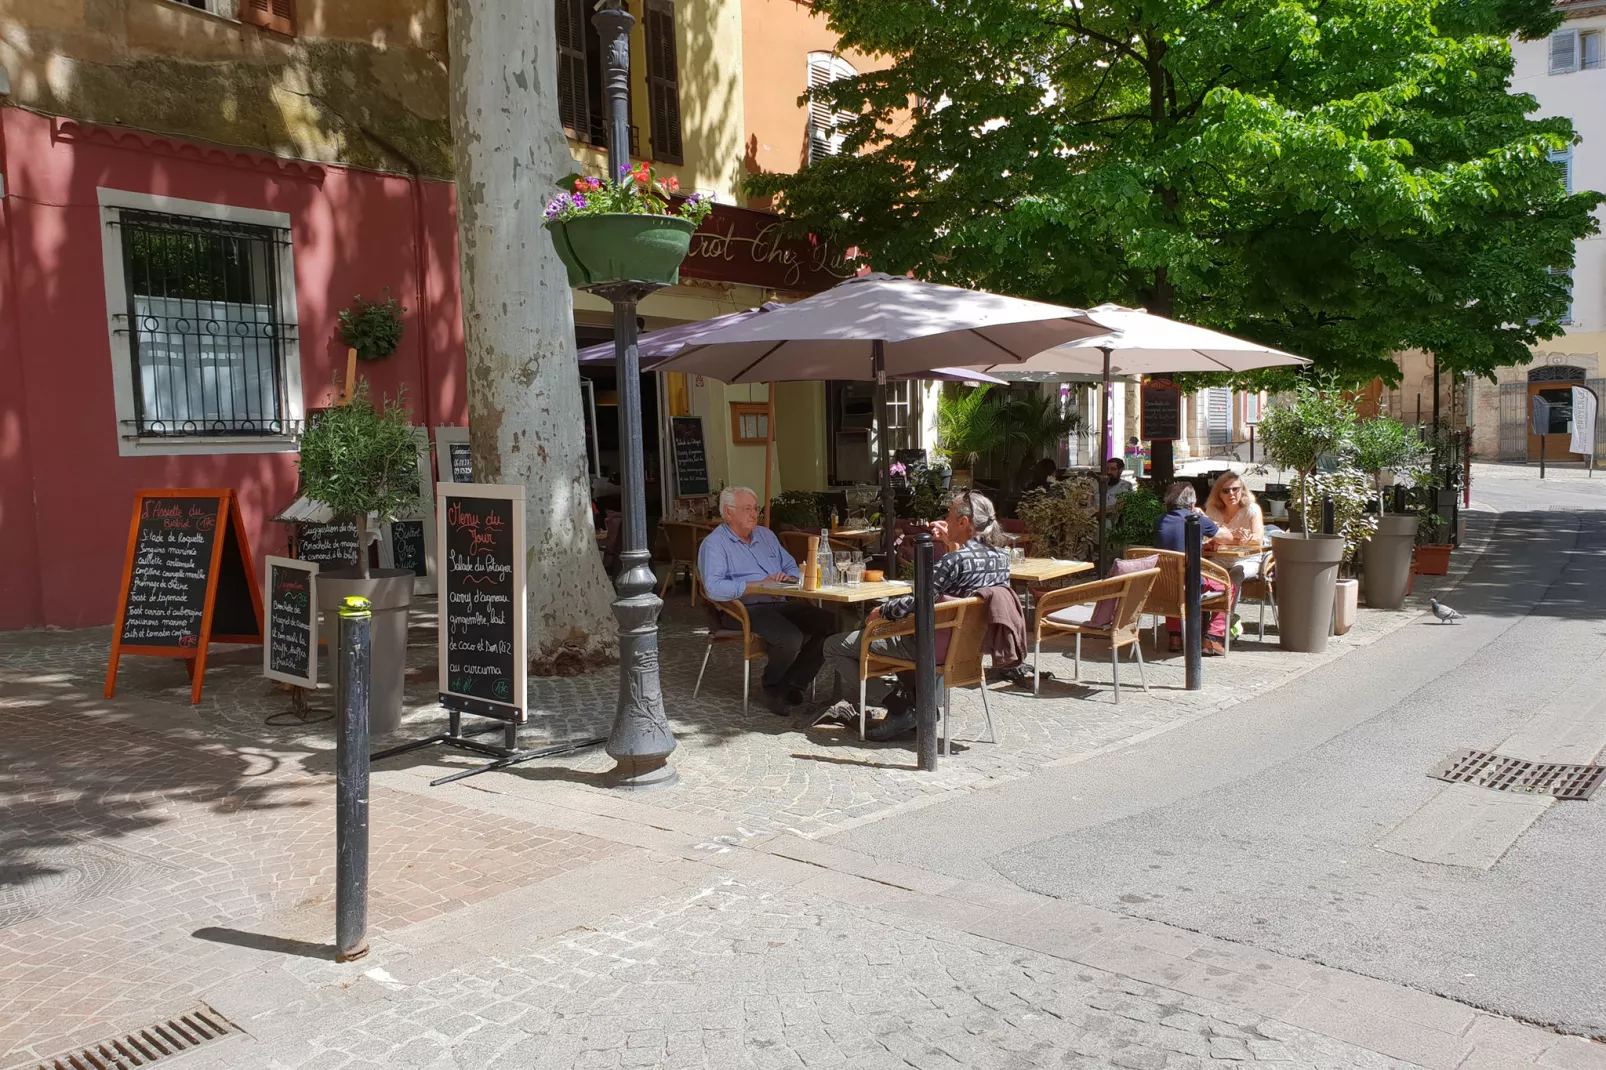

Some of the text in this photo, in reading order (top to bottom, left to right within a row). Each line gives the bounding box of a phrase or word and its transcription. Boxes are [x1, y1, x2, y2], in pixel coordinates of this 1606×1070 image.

[752, 220, 805, 287] Chez
[189, 504, 205, 516] du
[448, 501, 505, 525] Menu du
[168, 531, 176, 542] de
[333, 539, 339, 548] de
[469, 529, 496, 555] Jour
[450, 549, 512, 582] Salade du Potager
[474, 589, 511, 612] d'agneau
[490, 608, 506, 624] lait
[449, 637, 457, 651] de
[458, 641, 476, 651] coco
[477, 638, 484, 651] et
[450, 664, 502, 675] au curcuma
